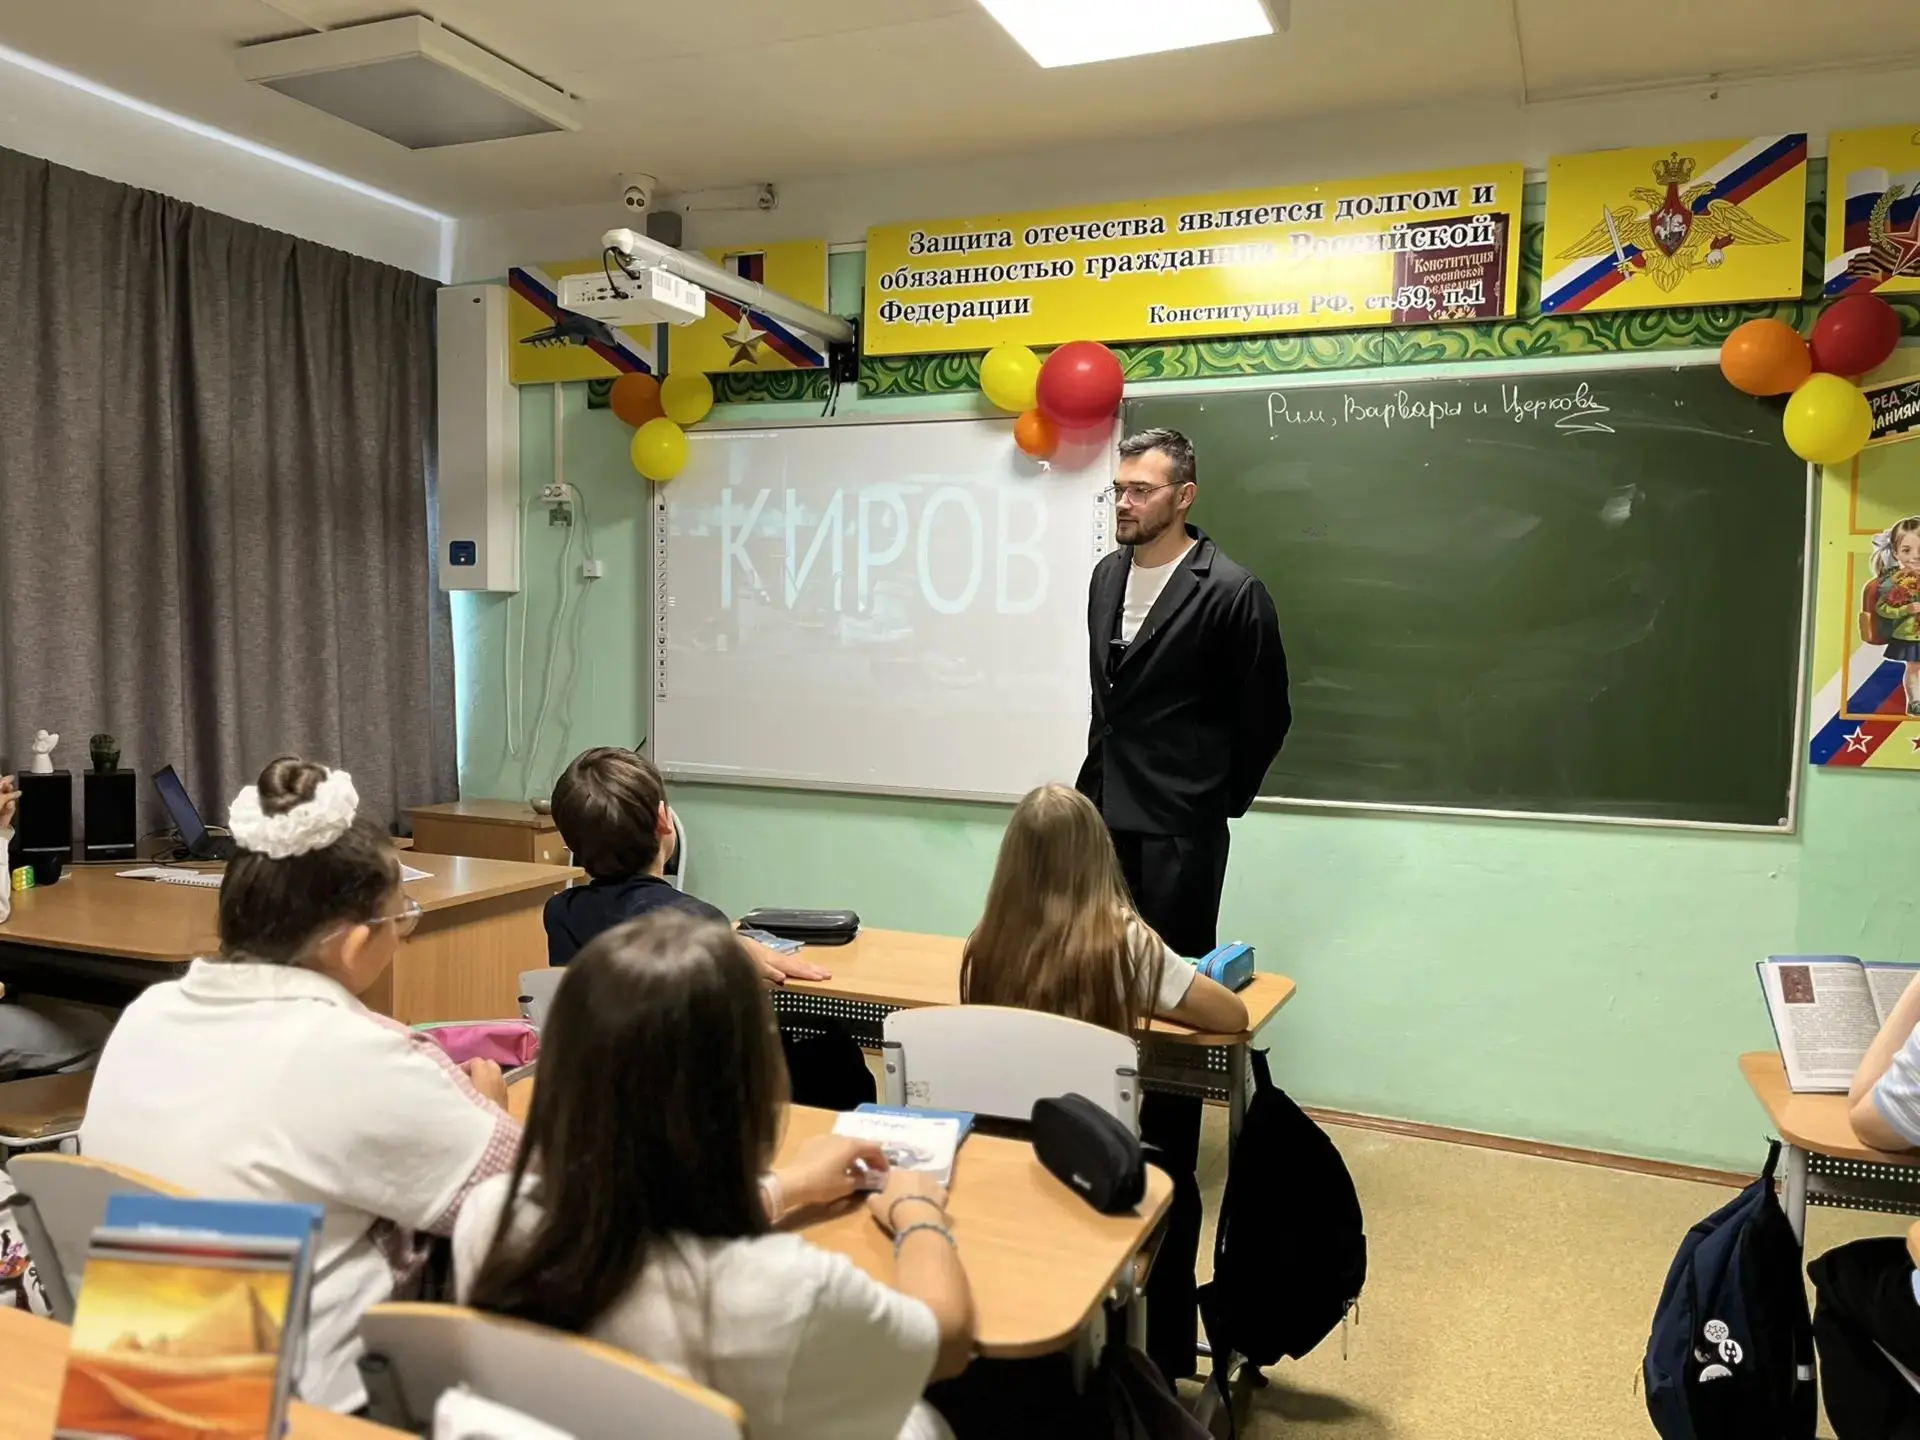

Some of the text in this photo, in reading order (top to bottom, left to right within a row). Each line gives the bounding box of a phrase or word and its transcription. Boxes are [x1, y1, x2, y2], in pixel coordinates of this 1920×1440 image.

[909, 184, 1494, 255] Защита отечества является долгом и
[880, 259, 1074, 291] обязанностью
[1289, 216, 1494, 260] Российской
[880, 297, 1032, 325] Федерации
[1149, 301, 1299, 323] Конституция
[1309, 293, 1354, 314] РФ,
[1443, 282, 1485, 306] п.1
[1268, 382, 1608, 429] Рим, Варвары и Церковь
[1868, 390, 1901, 412] РЕД
[720, 485, 1050, 615] КИРОВ
